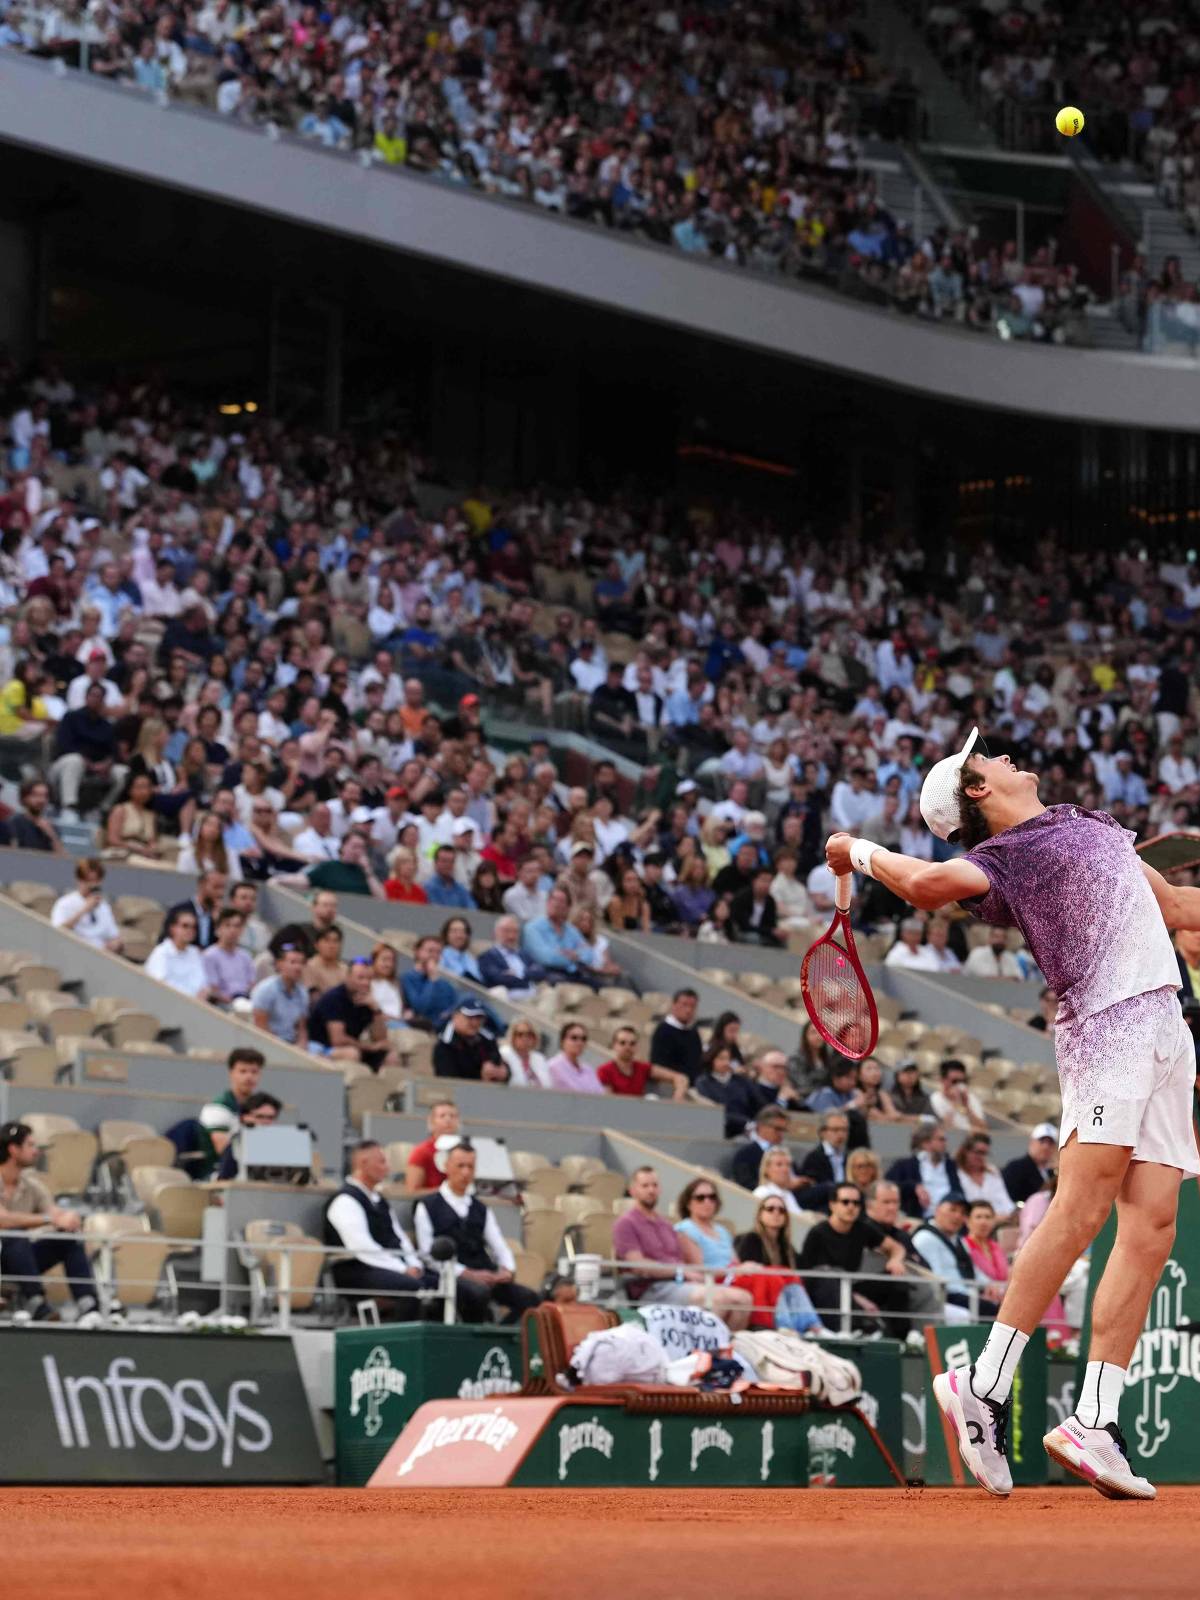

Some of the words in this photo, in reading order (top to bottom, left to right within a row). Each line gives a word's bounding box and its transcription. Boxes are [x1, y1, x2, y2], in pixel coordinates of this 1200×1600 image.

[42, 1355, 273, 1468] Infosys
[397, 1406, 519, 1476] Perrier
[559, 1416, 614, 1480] Perrier
